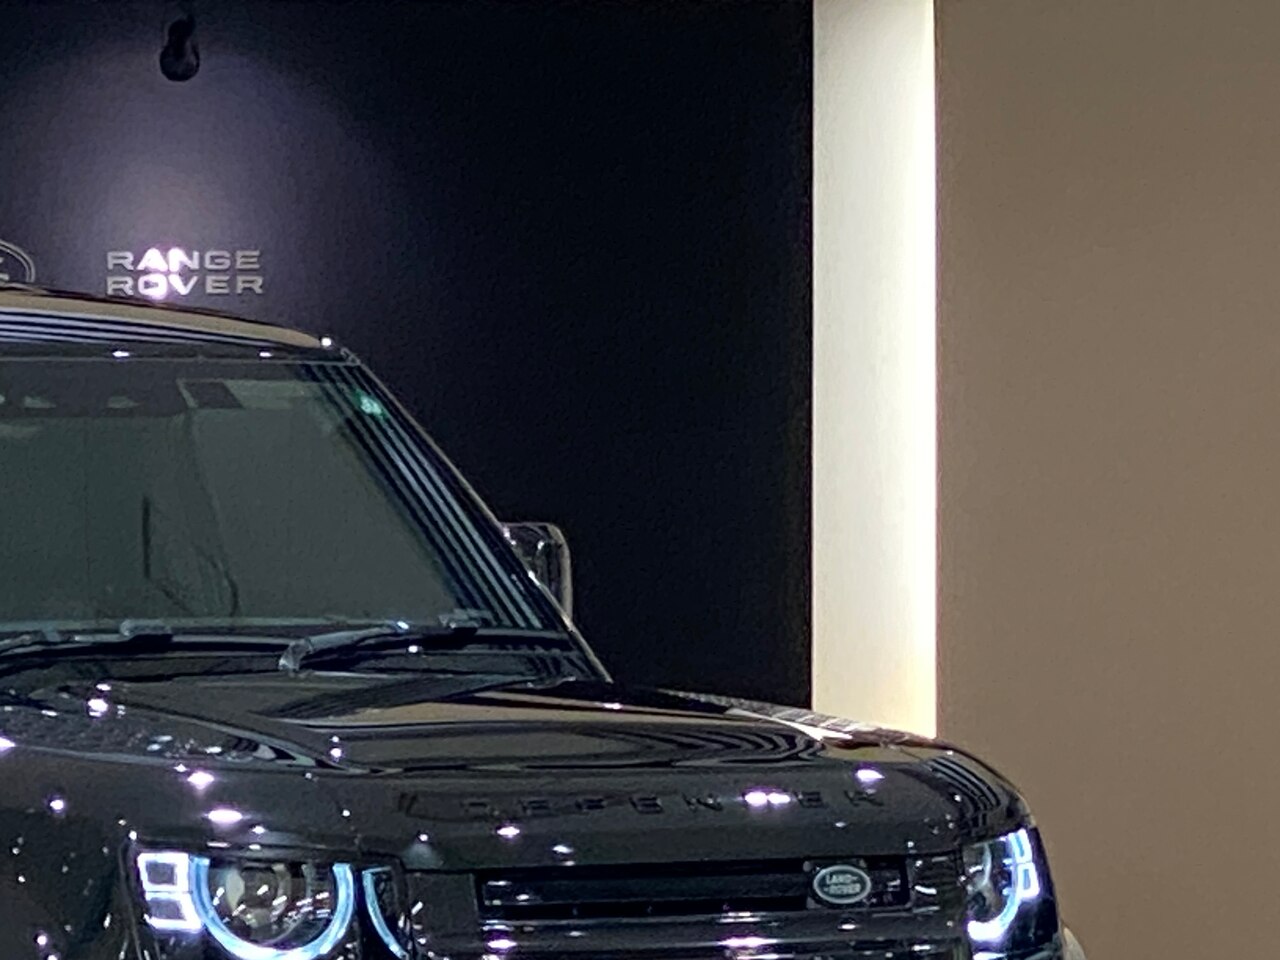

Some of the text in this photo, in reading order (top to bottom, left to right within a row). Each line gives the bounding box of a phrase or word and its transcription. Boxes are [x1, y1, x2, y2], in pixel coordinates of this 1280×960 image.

[107, 248, 260, 271] RANGE
[106, 274, 263, 298] ROVER
[461, 790, 885, 817] DEFENER
